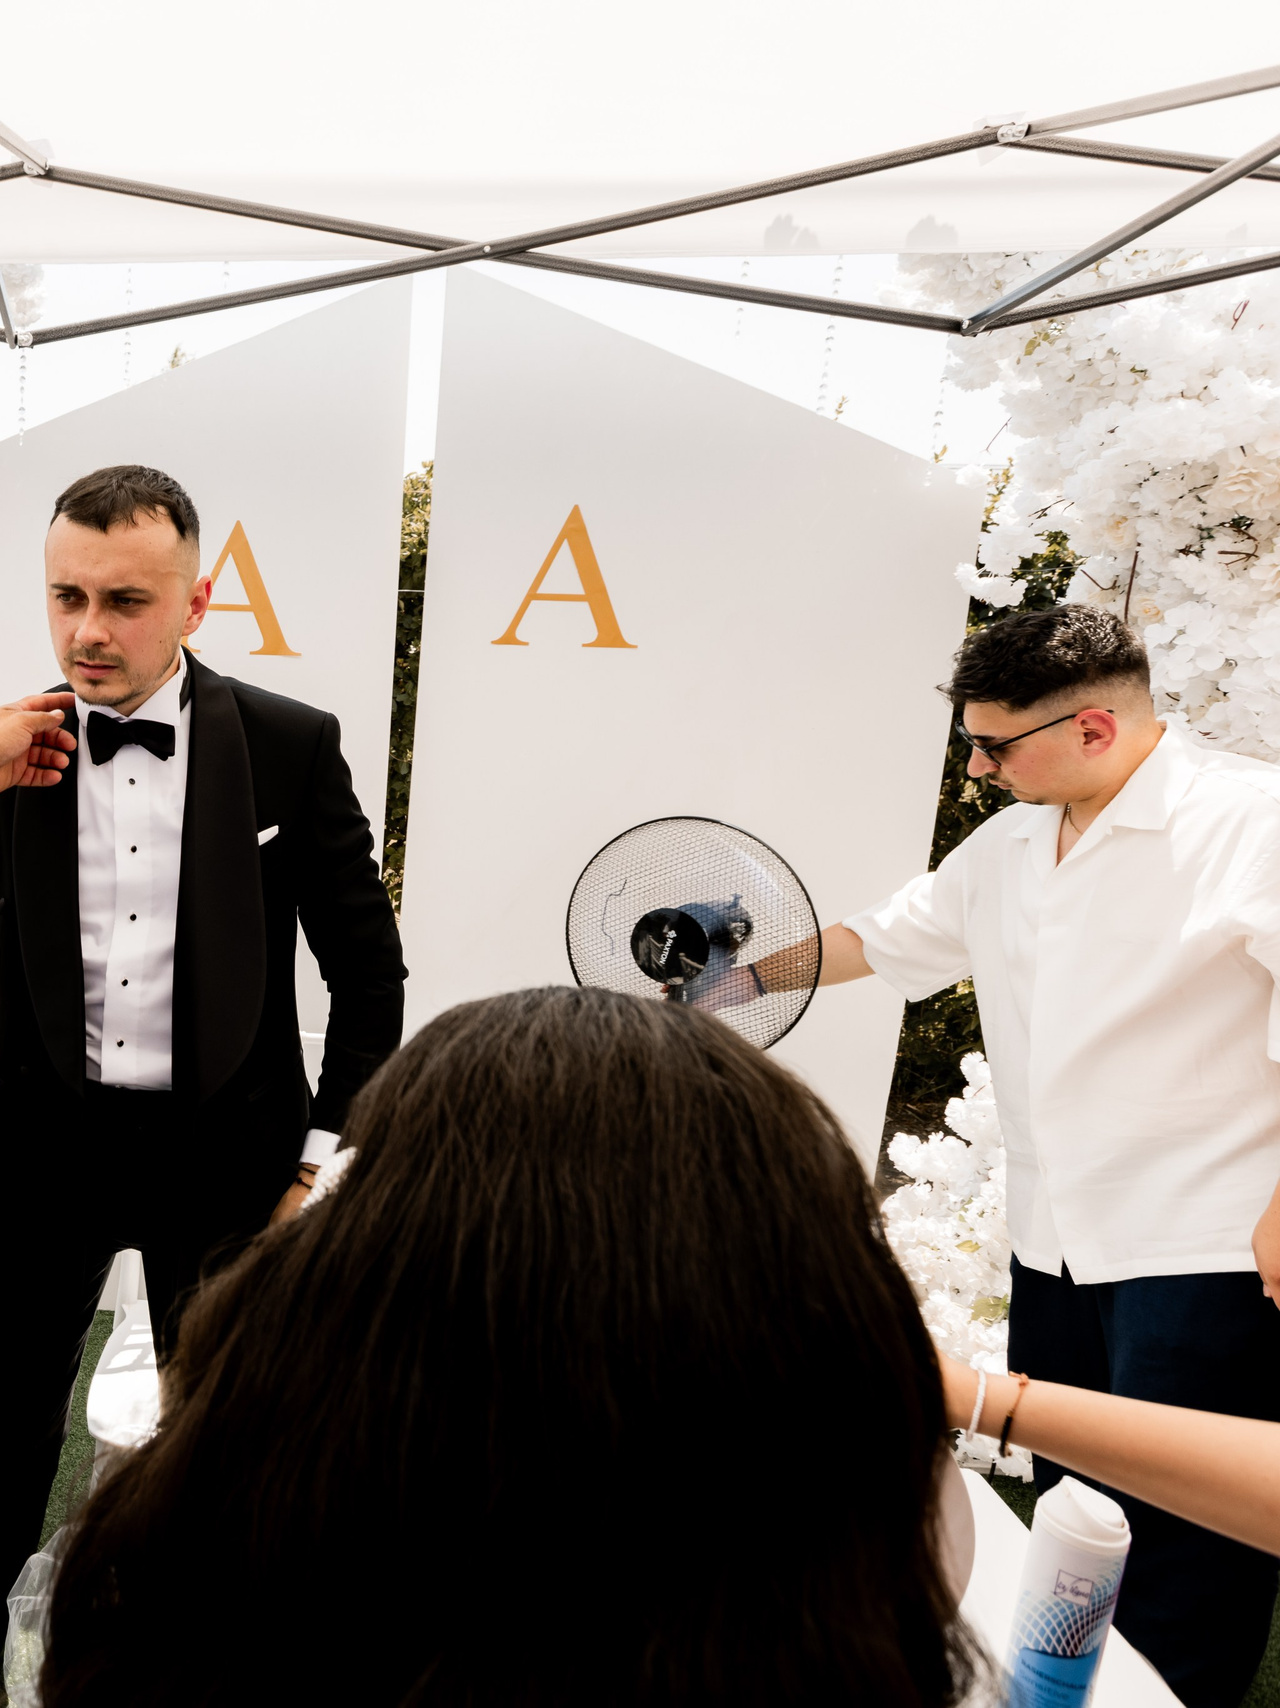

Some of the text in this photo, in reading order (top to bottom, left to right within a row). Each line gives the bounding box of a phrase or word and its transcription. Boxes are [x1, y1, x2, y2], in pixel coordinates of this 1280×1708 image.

[181, 519, 302, 657] A
[490, 504, 638, 649] A
[660, 938, 673, 965] PAXTON
